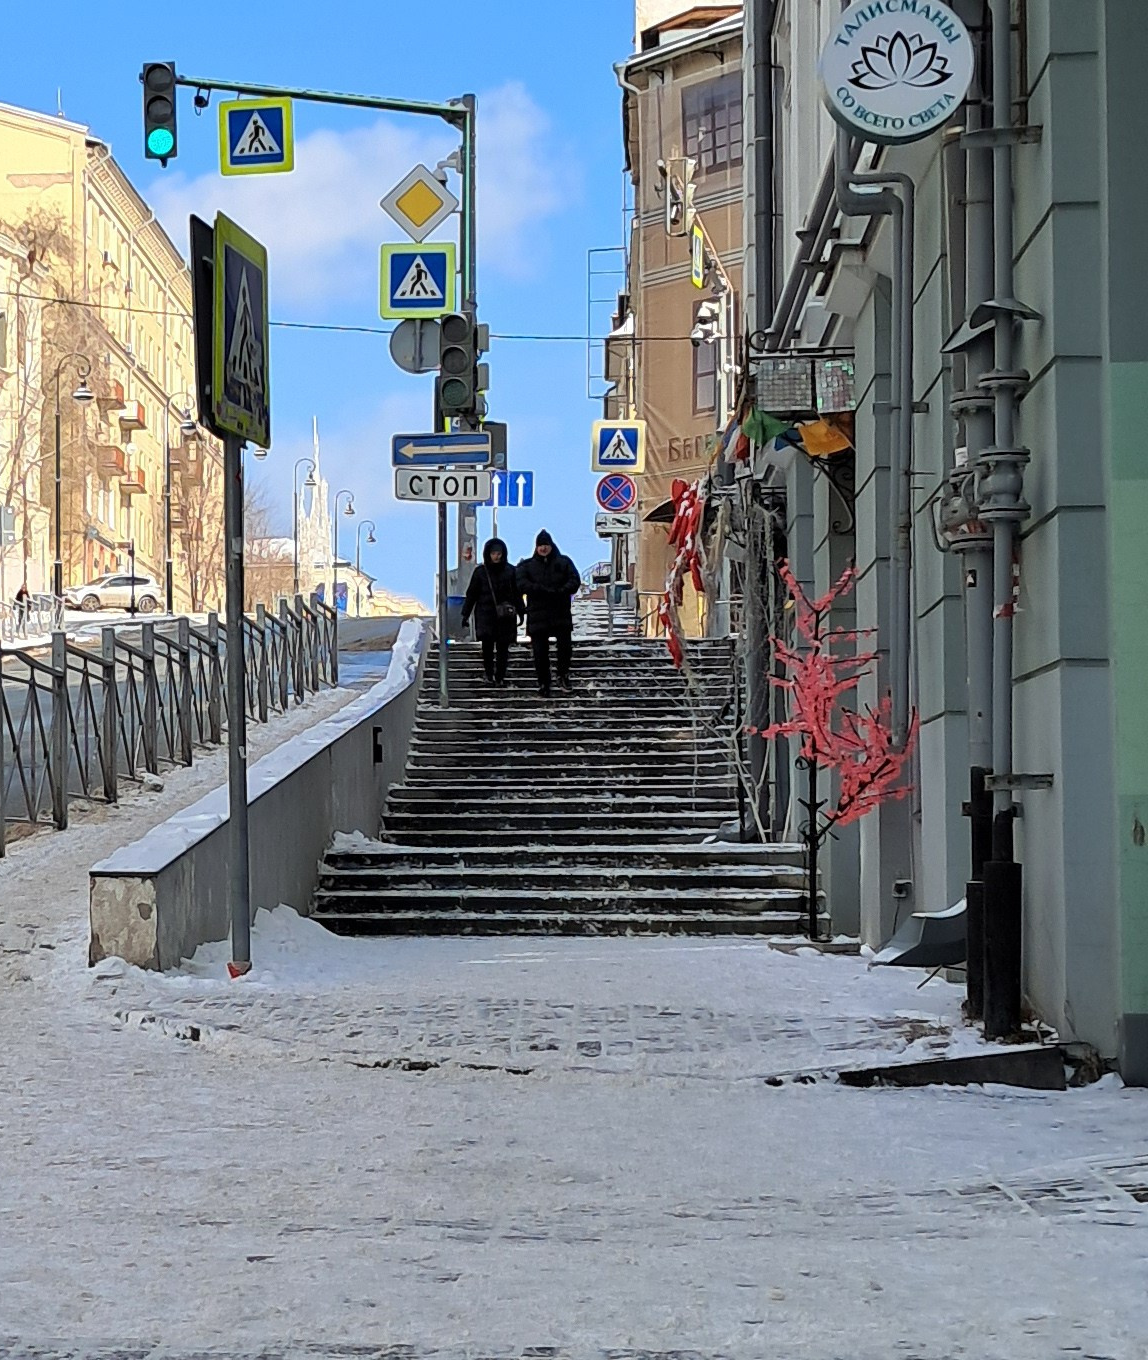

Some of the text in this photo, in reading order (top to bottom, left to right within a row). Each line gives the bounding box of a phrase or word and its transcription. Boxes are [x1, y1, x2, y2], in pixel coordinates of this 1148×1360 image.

[836, 86, 956, 130] СО ВСЕГО СВЕТА
[409, 474, 478, 497] СТОП
